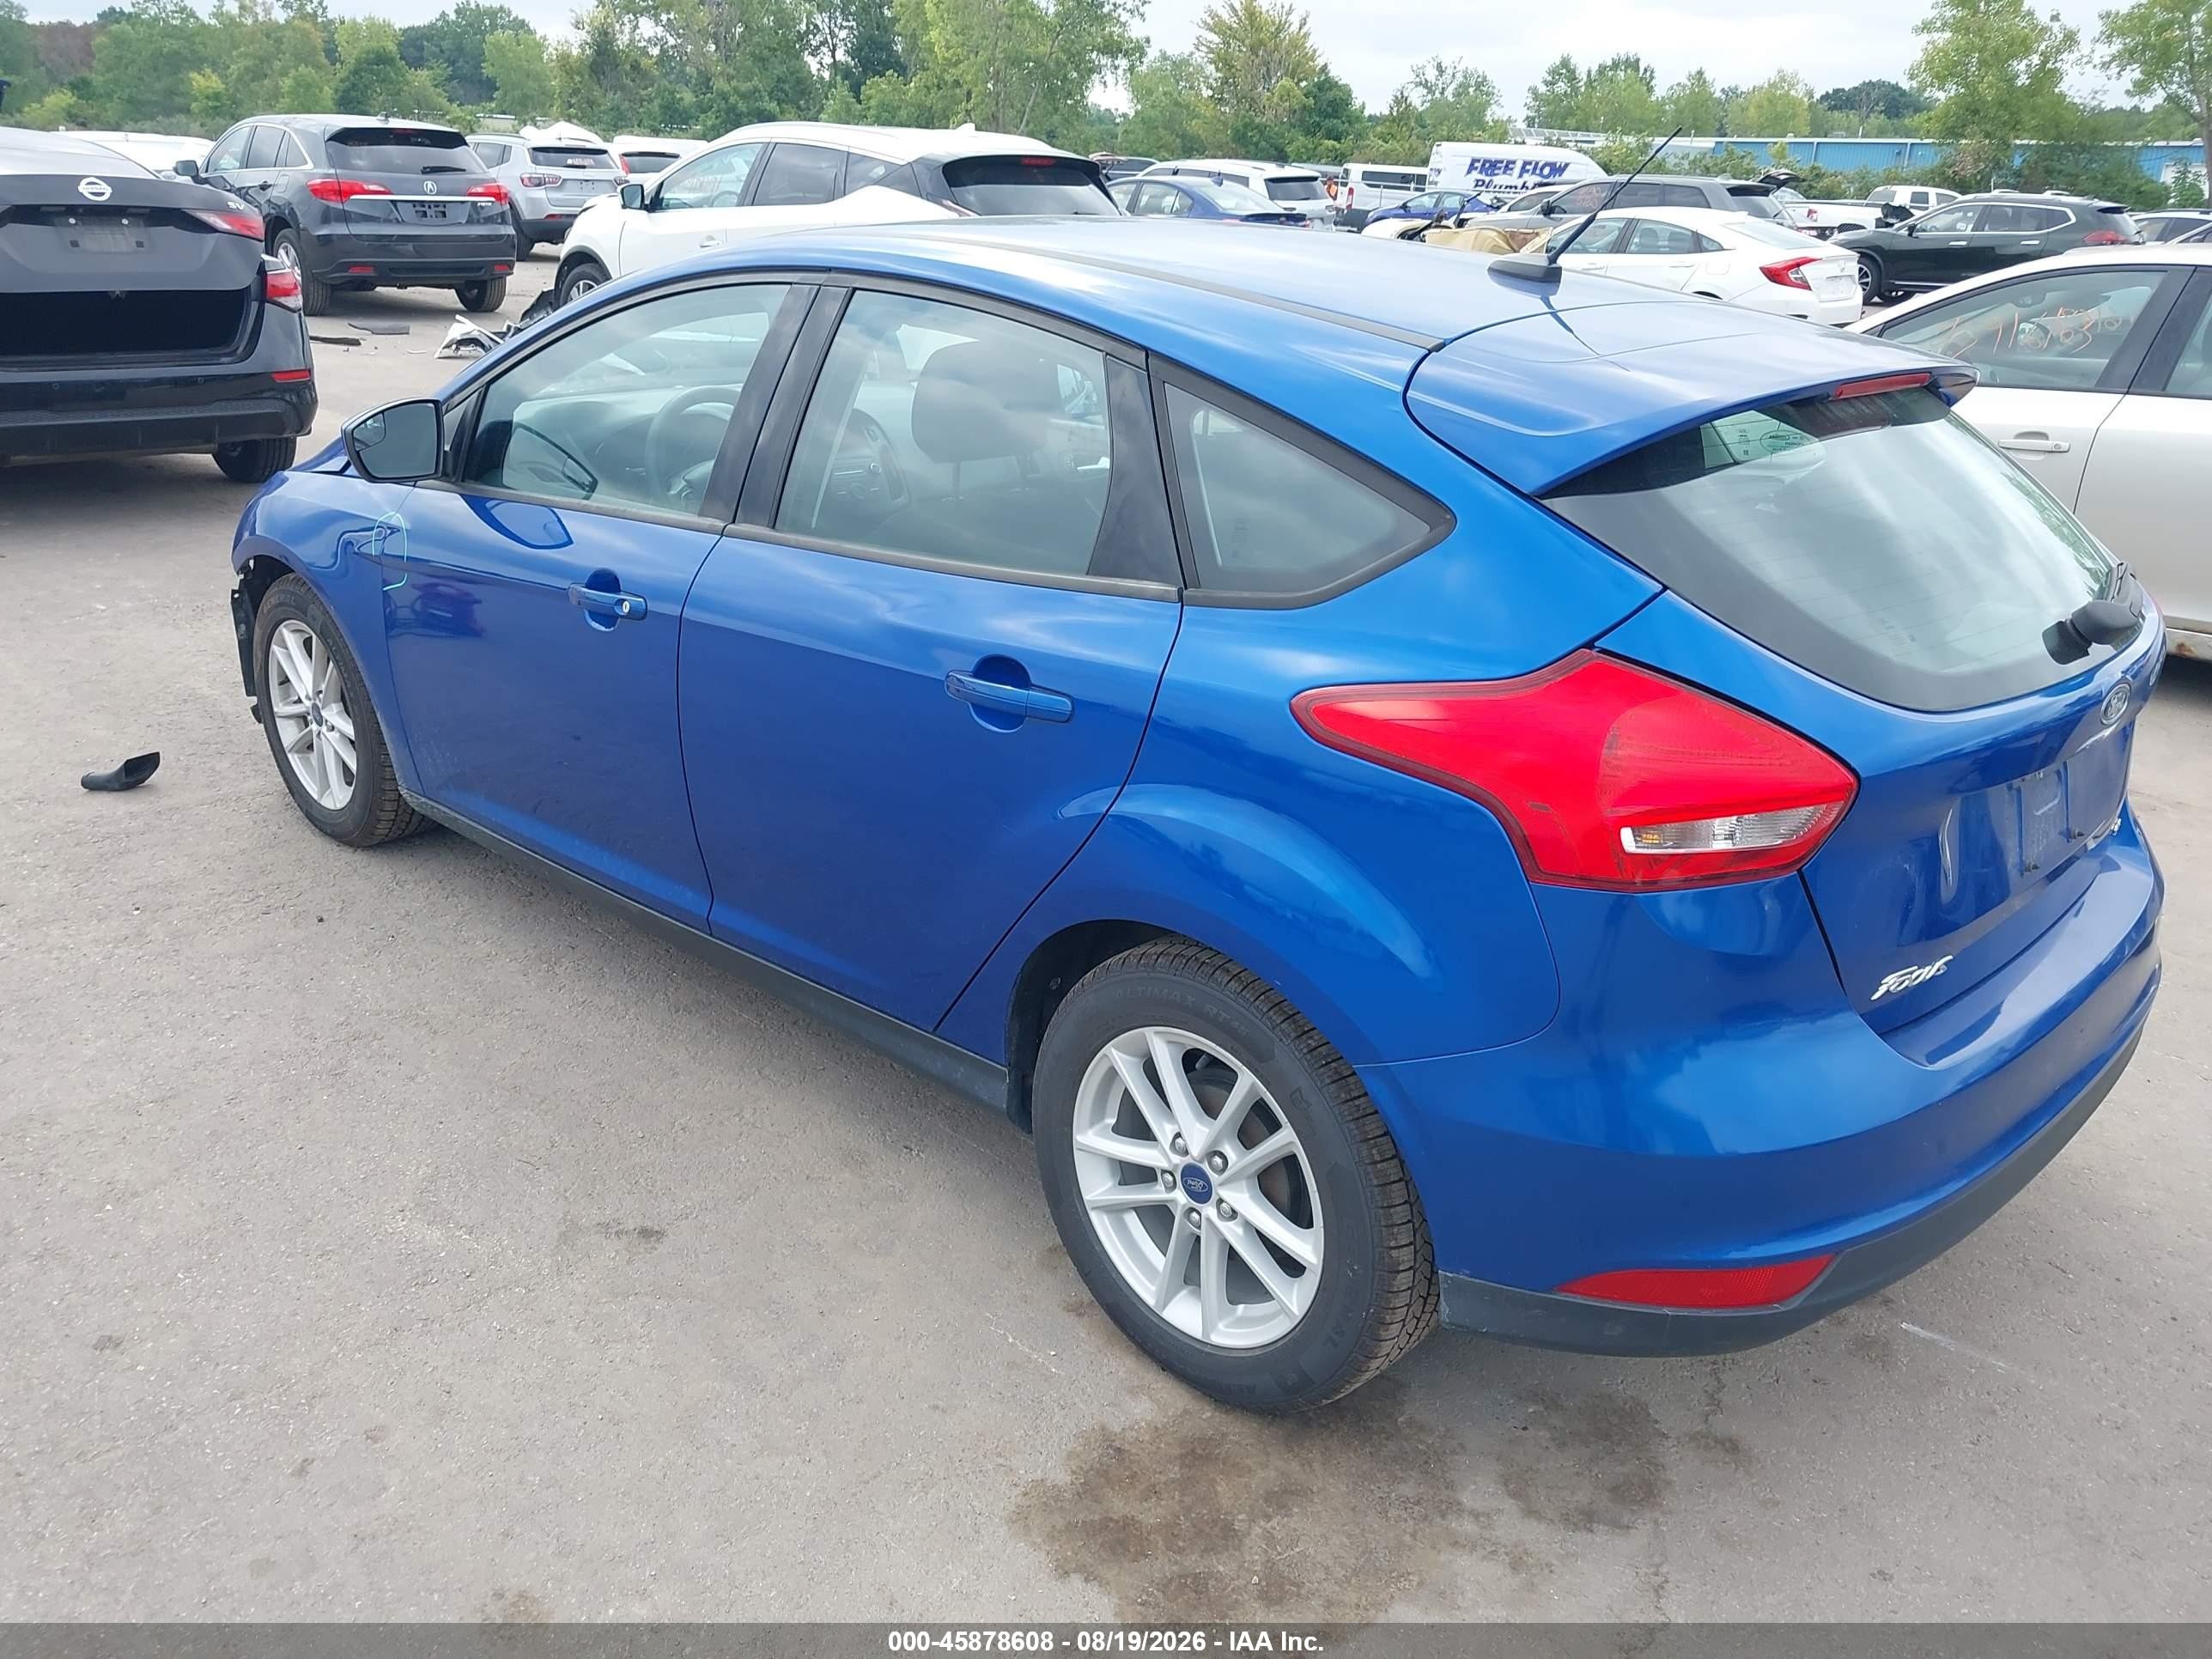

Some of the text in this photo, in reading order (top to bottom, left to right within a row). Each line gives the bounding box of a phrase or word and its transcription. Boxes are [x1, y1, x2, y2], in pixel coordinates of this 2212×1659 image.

[1465, 158, 1516, 177] FREE
[1518, 160, 1571, 179] FLOW
[227, 201, 245, 210] SV
[1114, 986, 1196, 1008] ALTIMAX
